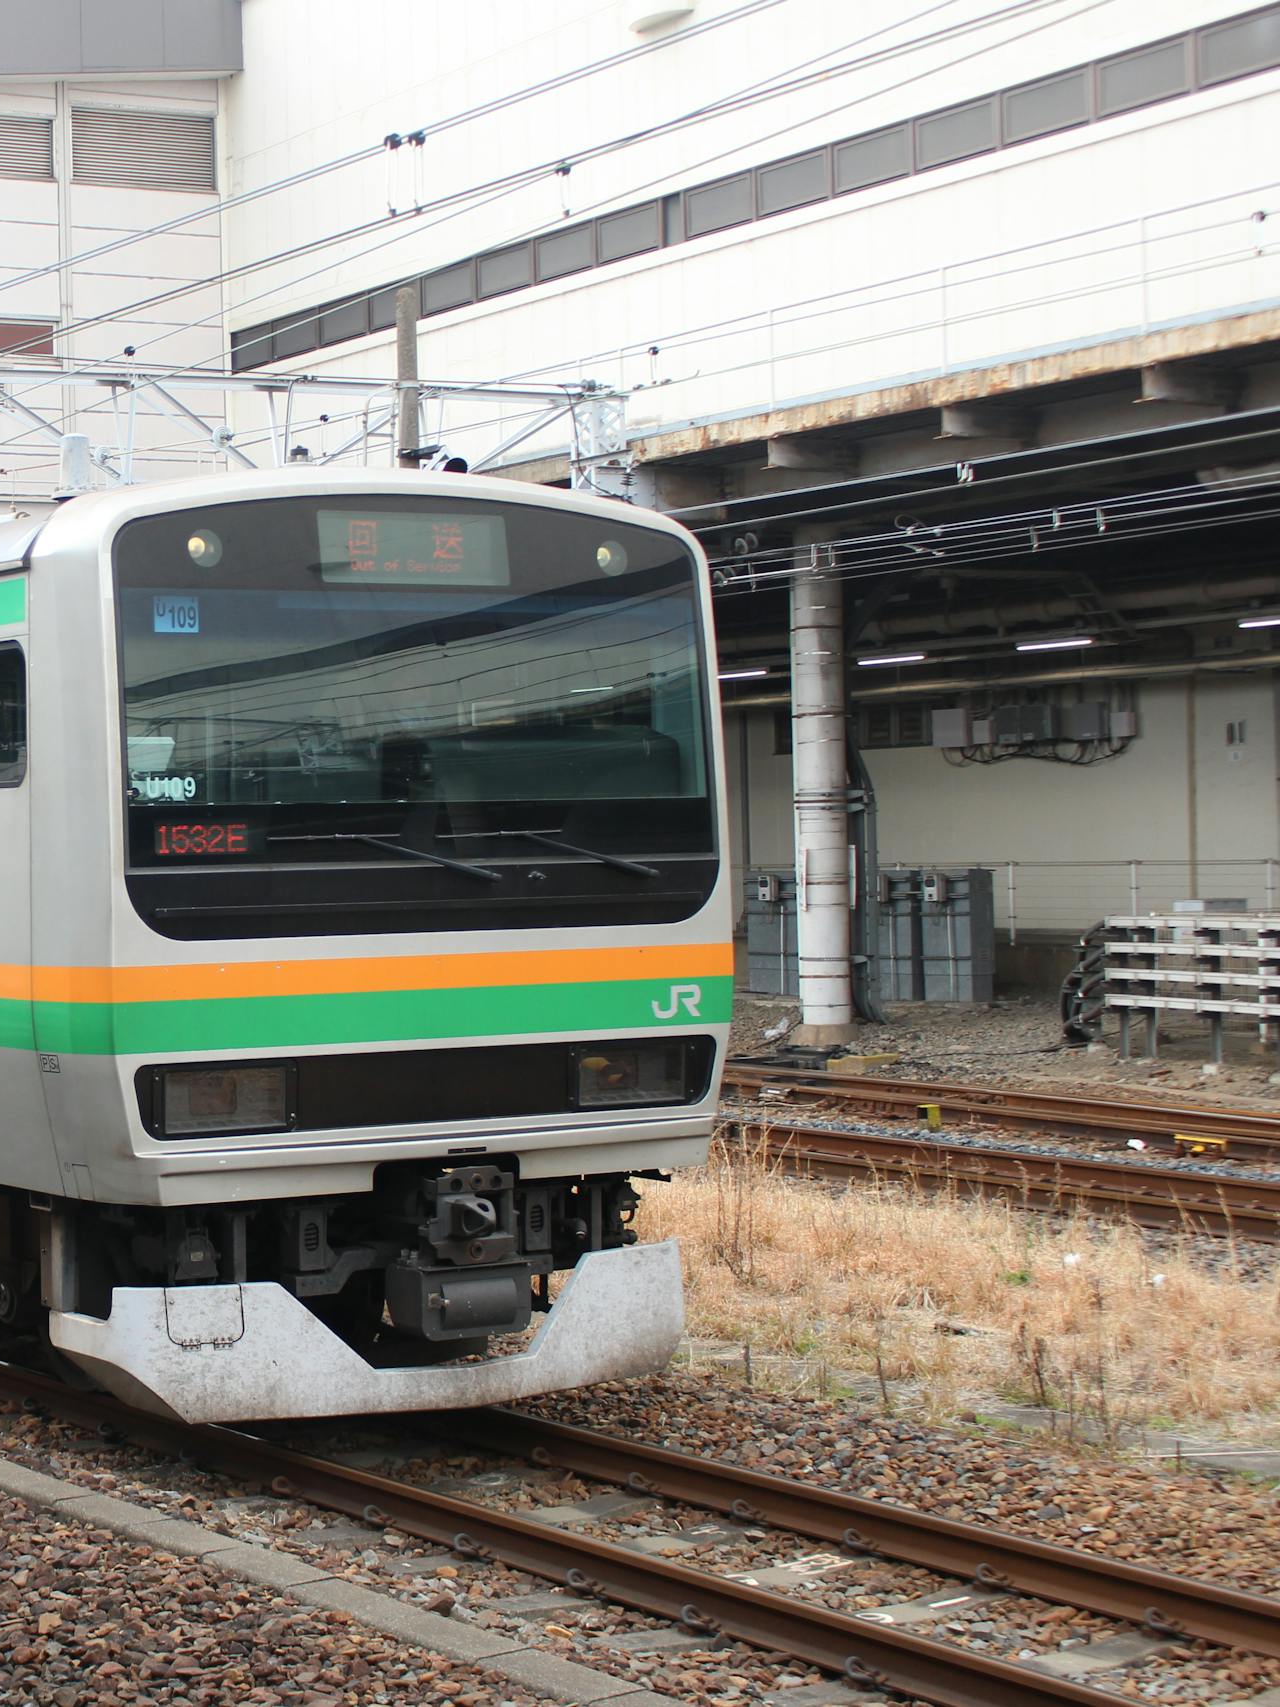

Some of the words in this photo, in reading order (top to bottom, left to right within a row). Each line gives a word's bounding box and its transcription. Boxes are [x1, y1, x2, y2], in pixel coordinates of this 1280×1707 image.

[146, 776, 197, 799] U109
[158, 824, 248, 854] 1532E
[651, 984, 701, 1019] JR
